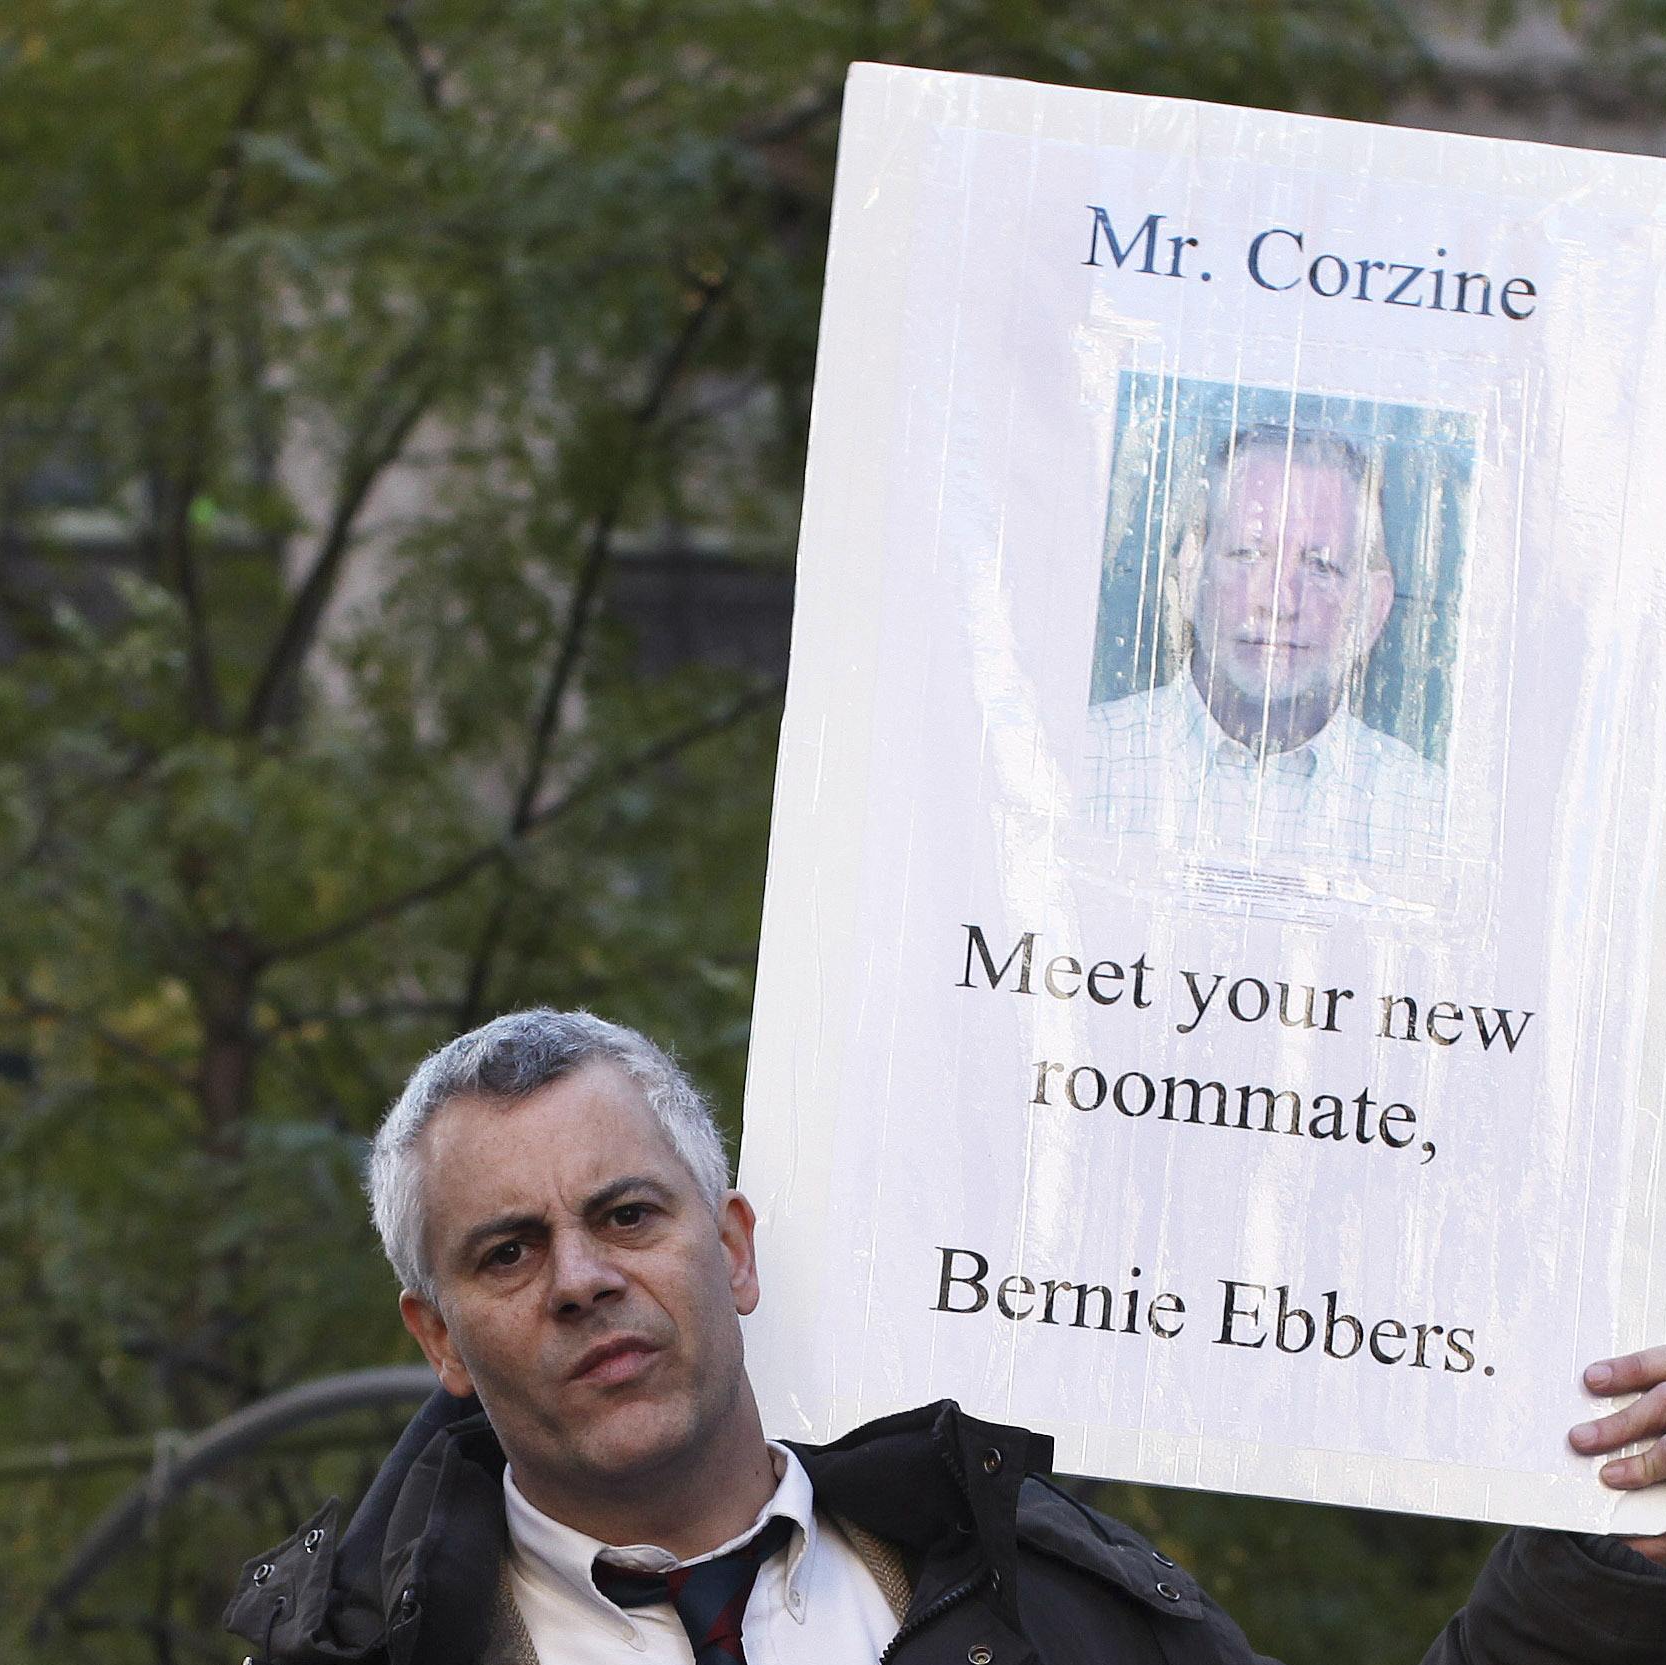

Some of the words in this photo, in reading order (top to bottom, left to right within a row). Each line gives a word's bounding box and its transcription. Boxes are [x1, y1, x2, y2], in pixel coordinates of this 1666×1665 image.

[1081, 204, 1211, 282] Mr.
[1247, 228, 1537, 321] Corzine
[954, 923, 1155, 1009] Meet
[1176, 970, 1354, 1033] your
[1376, 991, 1535, 1054] new
[1028, 1058, 1436, 1165] roommate,
[929, 1246, 1186, 1340] Bernie
[1211, 1279, 1495, 1376] Ebbers.
